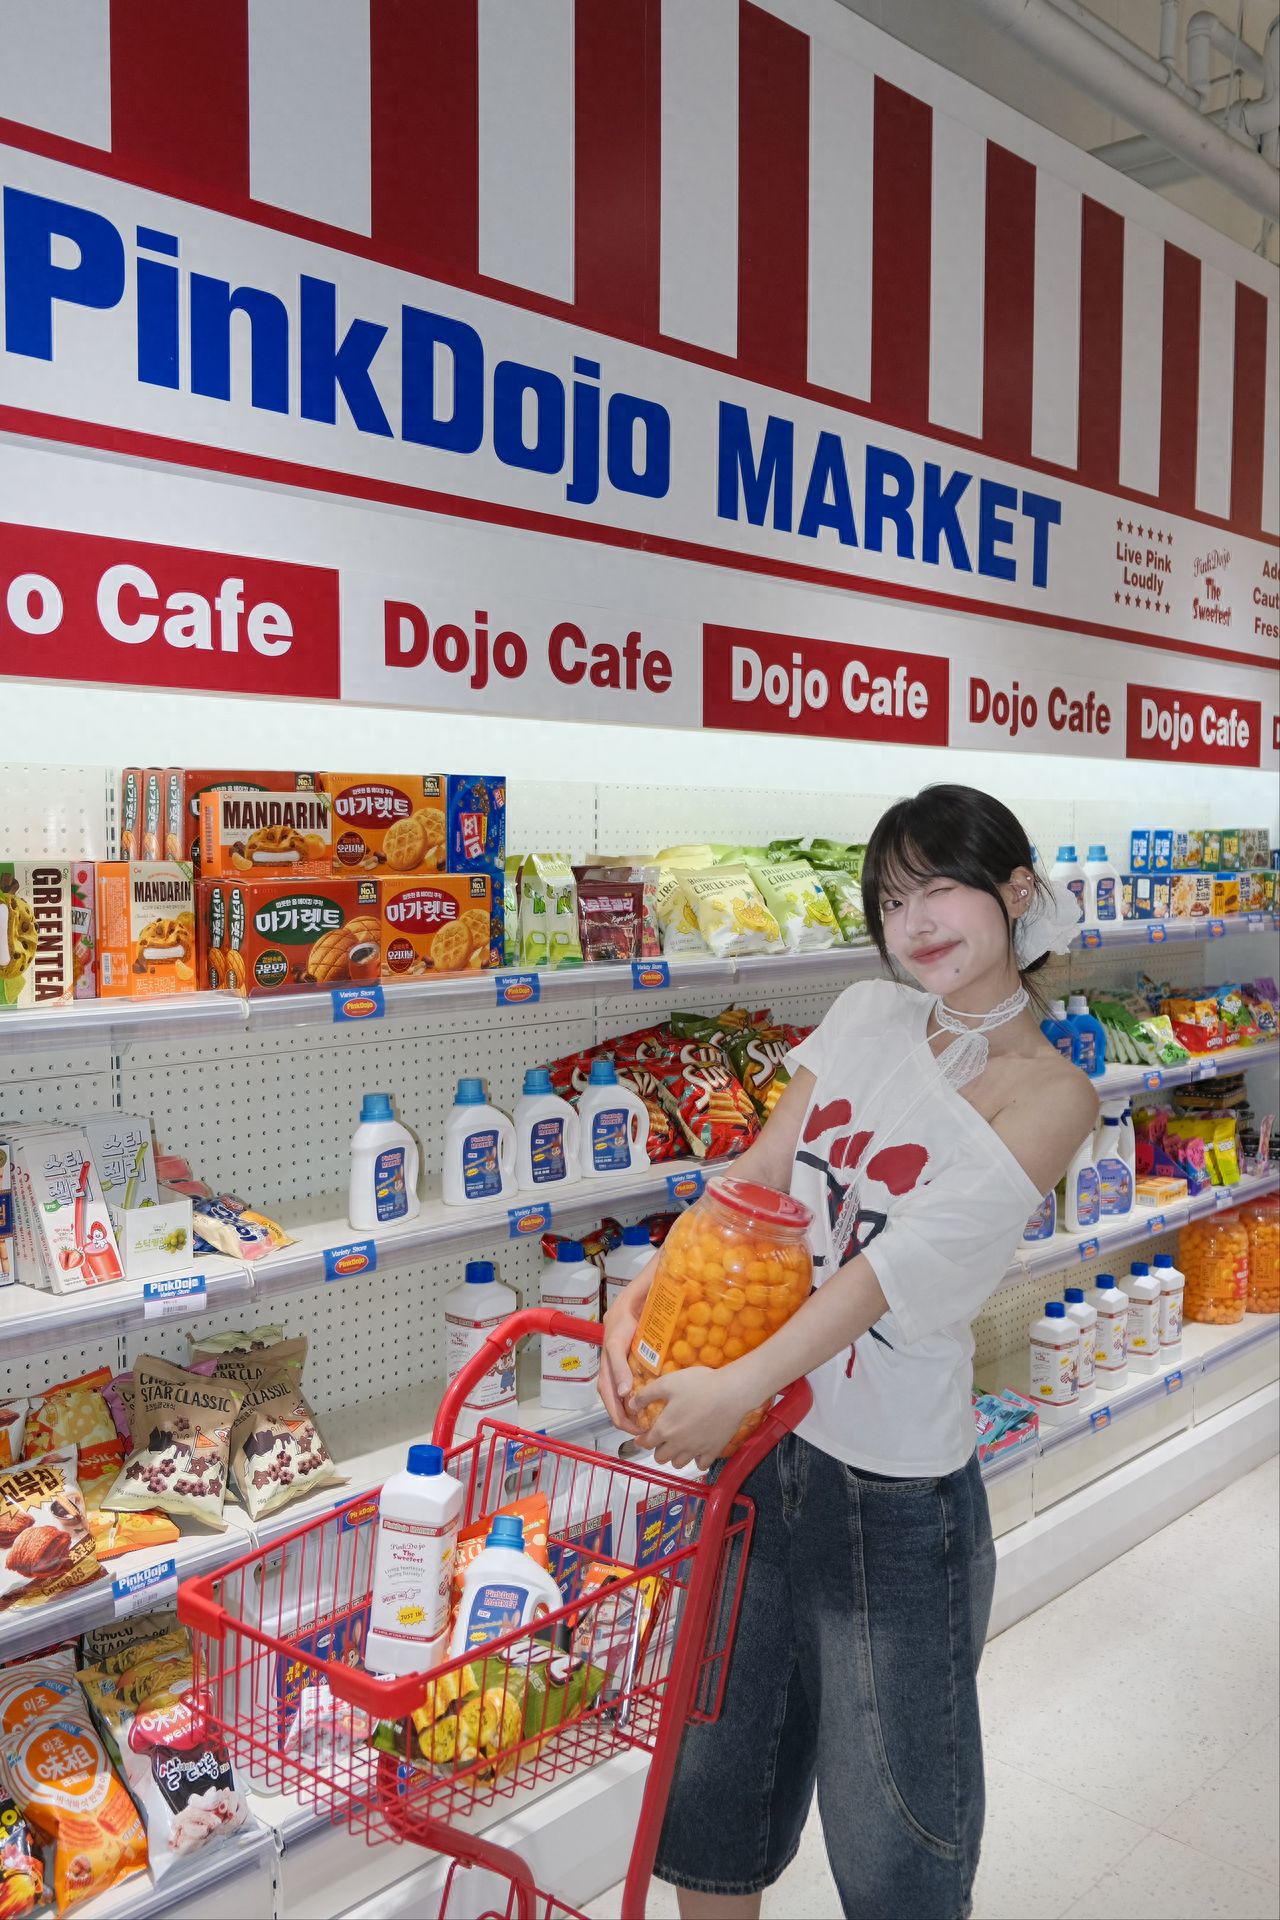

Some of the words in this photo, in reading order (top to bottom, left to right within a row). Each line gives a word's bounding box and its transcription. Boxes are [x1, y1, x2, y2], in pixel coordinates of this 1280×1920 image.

[3, 185, 671, 506] PinkDojo
[717, 400, 1062, 590] MARKET
[1116, 541, 1142, 566] Live
[1146, 549, 1172, 574] Pink
[1123, 566, 1164, 597] Loudly
[1205, 576, 1222, 601] The
[7, 573, 64, 636] o
[96, 563, 294, 658] Cafe
[1192, 597, 1232, 627] Sweetest
[384, 599, 528, 690] Dojo
[547, 622, 673, 695] Cafe
[730, 645, 829, 719] Dojo
[841, 659, 929, 721] Cafe
[968, 676, 1038, 737] Dojo
[1047, 686, 1112, 735] Cafe
[1139, 697, 1195, 751] Dojo
[1199, 705, 1251, 748] Cafe
[425, 781, 438, 789] No.1
[223, 800, 329, 830] MANDARIN
[336, 796, 410, 818] 마가렛트
[134, 881, 192, 903] MANDARIN
[360, 888, 375, 896] No.1
[472, 881, 485, 889] No.1
[255, 908, 341, 933] 마가렛트
[386, 900, 457, 923] 마가렛트
[32, 868, 64, 1002] GREENTEA
[339, 990, 358, 999] Variety
[360, 989, 376, 998] Store
[514, 1208, 529, 1217] Variety
[529, 1205, 544, 1215] Store
[331, 1247, 352, 1258] Variety
[352, 1244, 368, 1256] Store
[338, 1257, 366, 1270] PinkDojo
[150, 1277, 199, 1294] PinkDojo
[140, 1385, 174, 1403] STAR
[174, 1388, 232, 1413] CLASSIC
[246, 1382, 292, 1408] CLASSIC
[392, 1553, 424, 1564] Sweetest
[402, 1549, 416, 1557] The
[119, 1562, 169, 1591] PinkDojo
[483, 1597, 518, 1609] MARKET
[400, 1612, 415, 1621] JUST
[415, 1611, 423, 1619] IN
